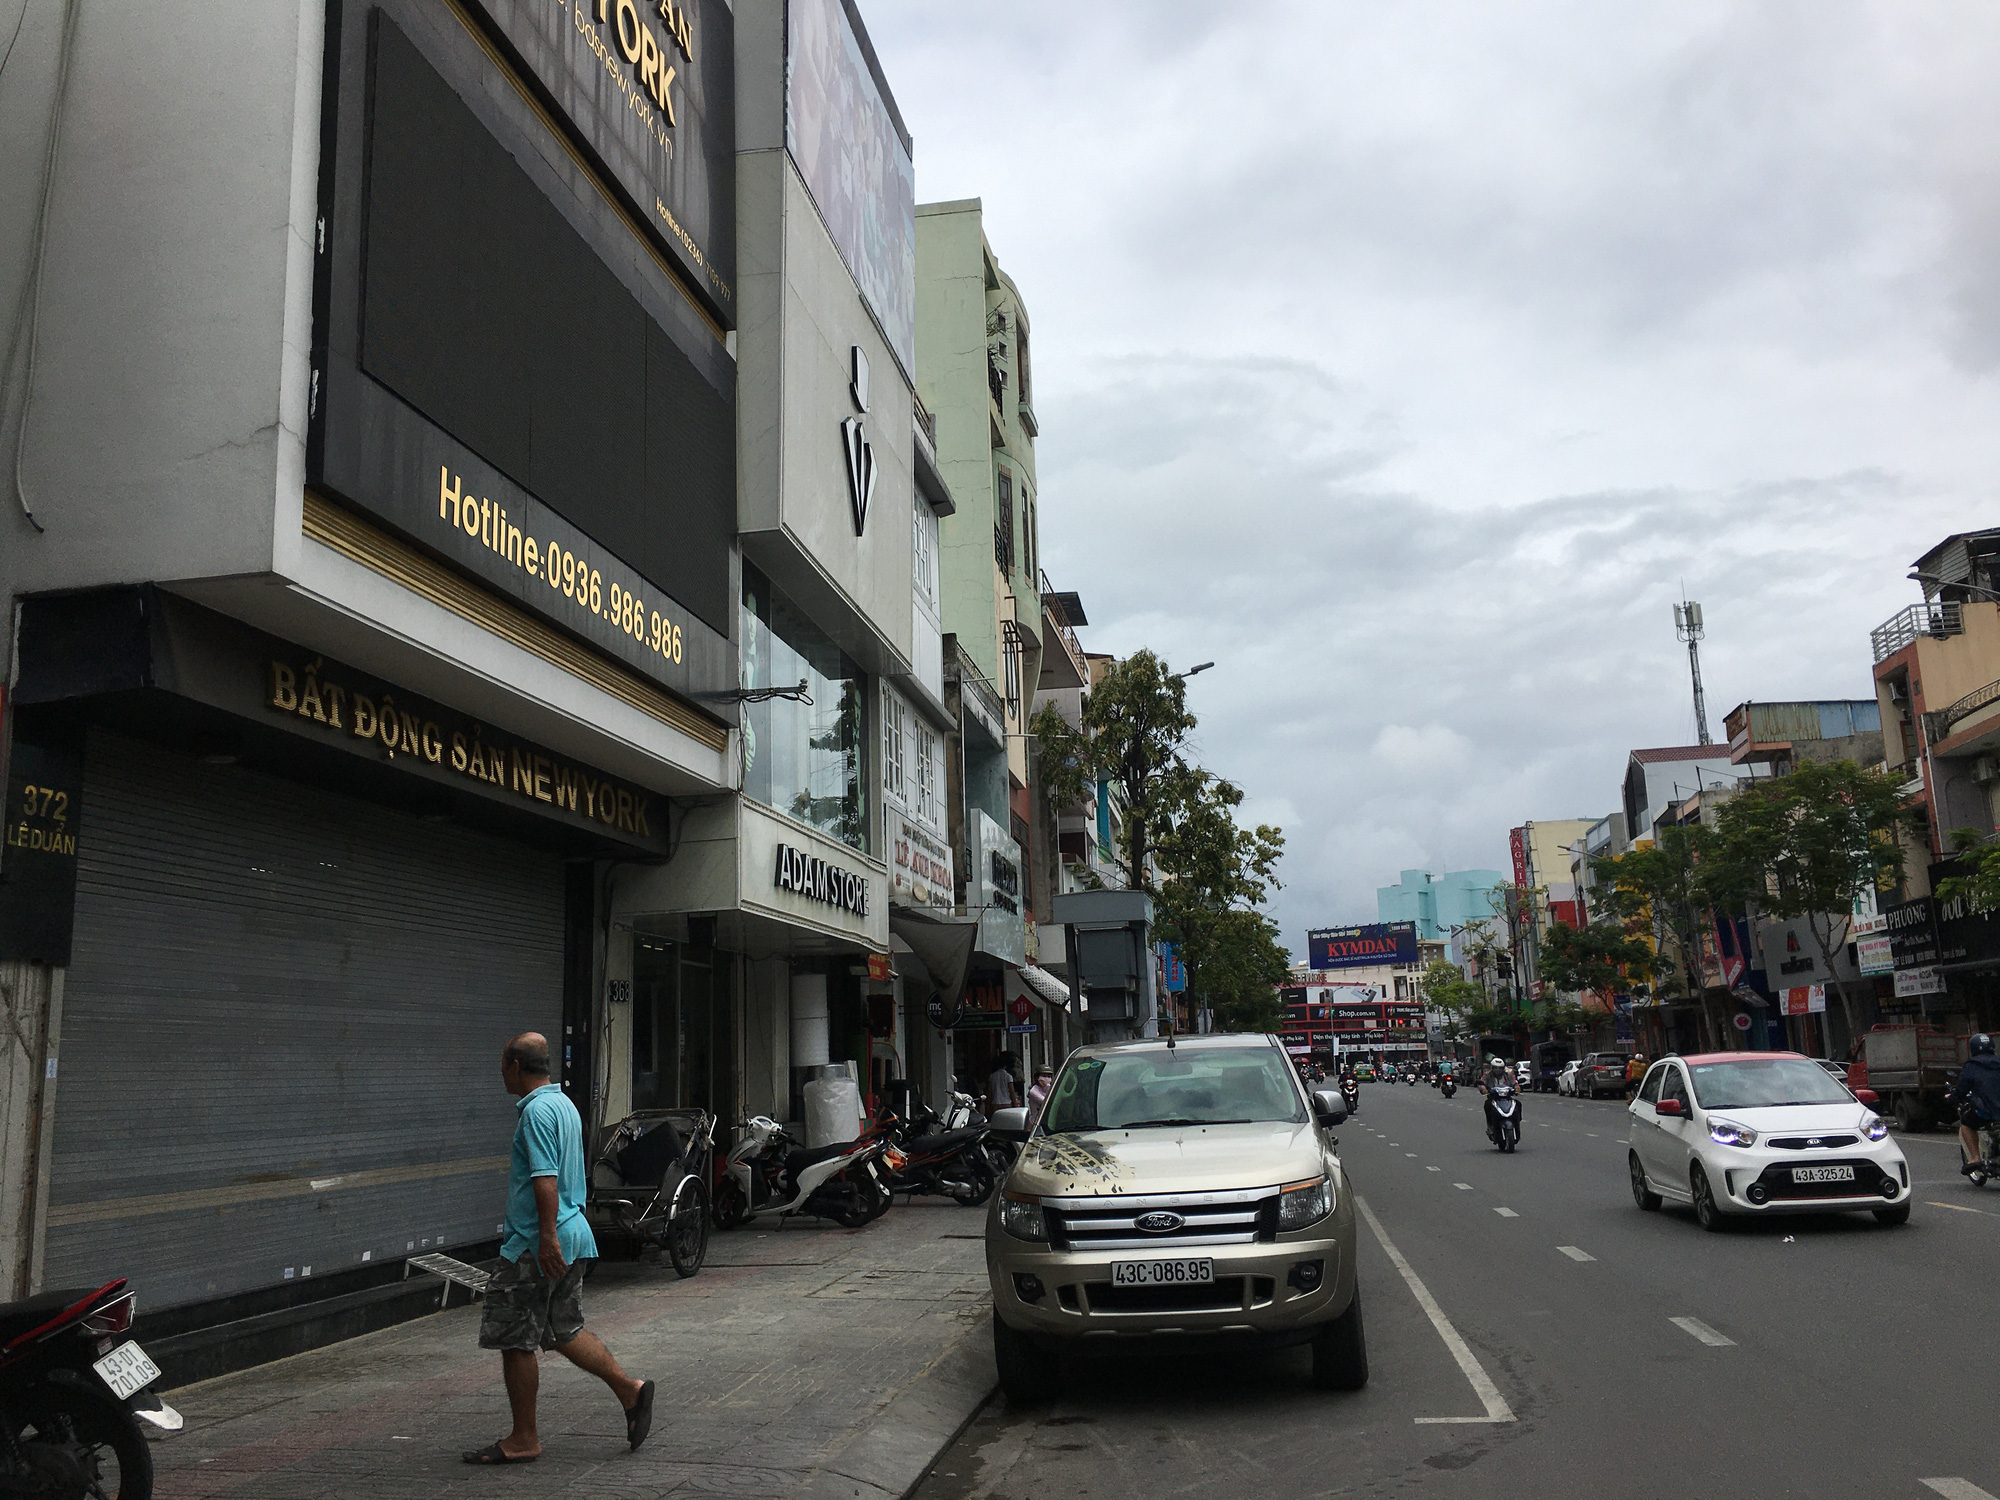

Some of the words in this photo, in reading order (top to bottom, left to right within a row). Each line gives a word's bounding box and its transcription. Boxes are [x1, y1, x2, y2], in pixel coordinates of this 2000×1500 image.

[439, 465, 682, 665] Hotline:0936.986.986
[273, 656, 343, 729] BẤT
[353, 692, 442, 765] ĐỘNG
[451, 724, 506, 787] SẢN
[23, 784, 69, 821] 372
[7, 821, 29, 848] LÊ
[775, 843, 828, 902] ADAM
[829, 865, 869, 916] STORE
[1327, 937, 1397, 957] KYMDAN
[1338, 1009, 1376, 1019] Shop.com.vn
[1145, 1213, 1172, 1227] Ford
[1115, 1260, 1210, 1284] 43C-086.95
[111, 1360, 156, 1396] 701.09
